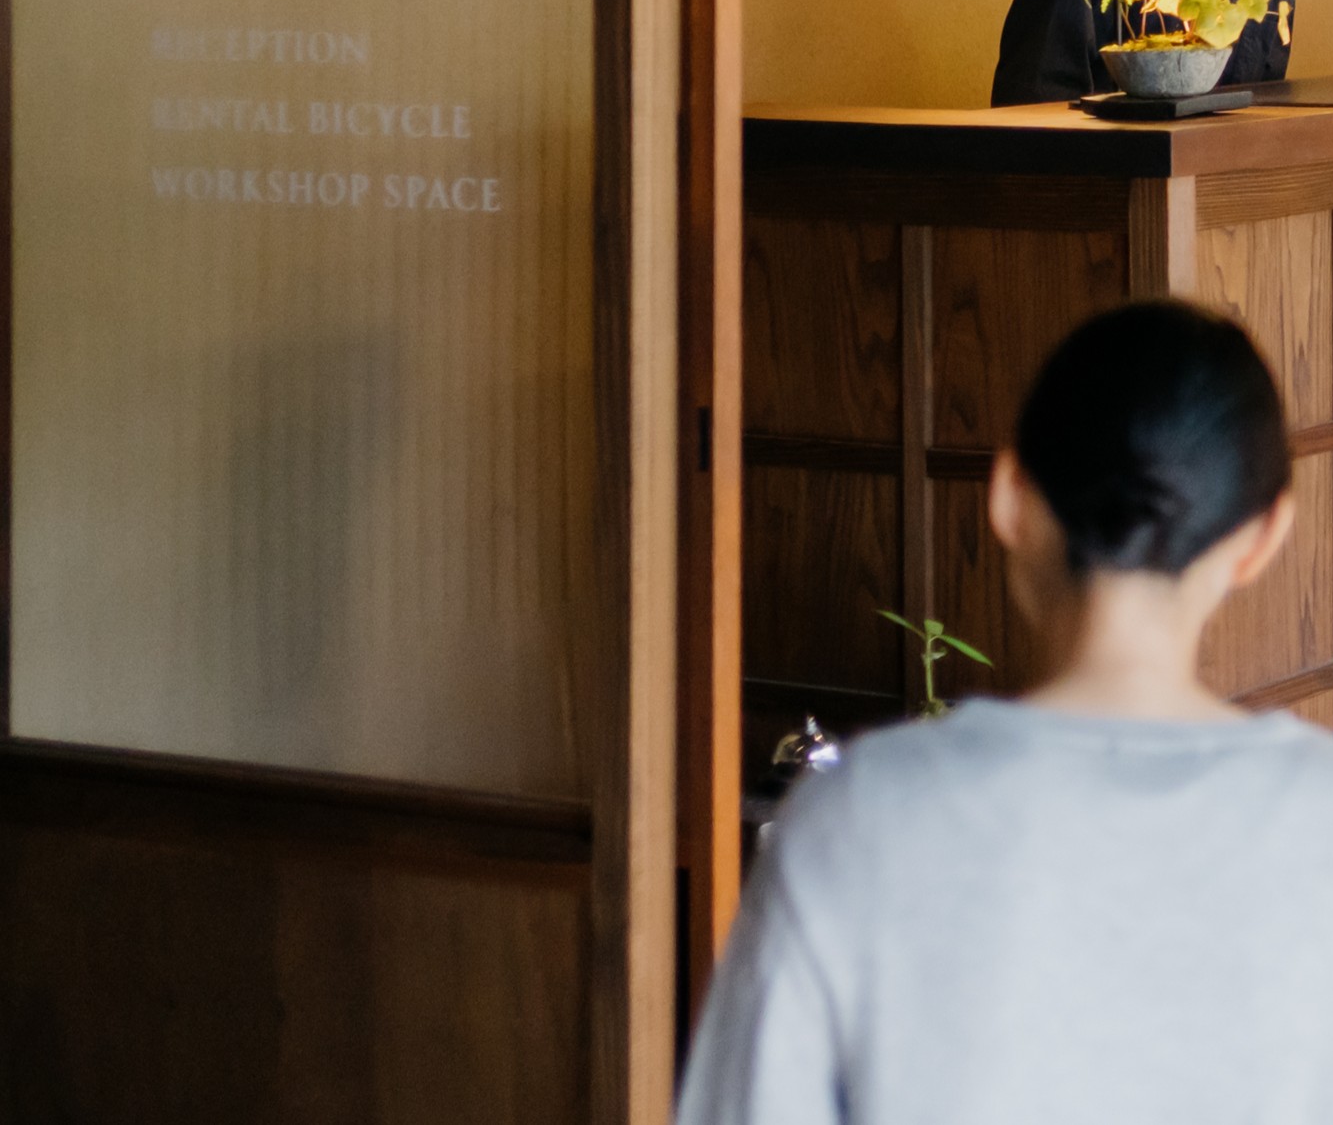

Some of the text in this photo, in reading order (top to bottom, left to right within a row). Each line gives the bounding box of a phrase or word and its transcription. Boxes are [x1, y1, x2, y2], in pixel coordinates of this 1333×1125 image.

[151, 98, 473, 139] RENTAL BICYCLE
[150, 166, 502, 212] WORKSHOP SPACE
